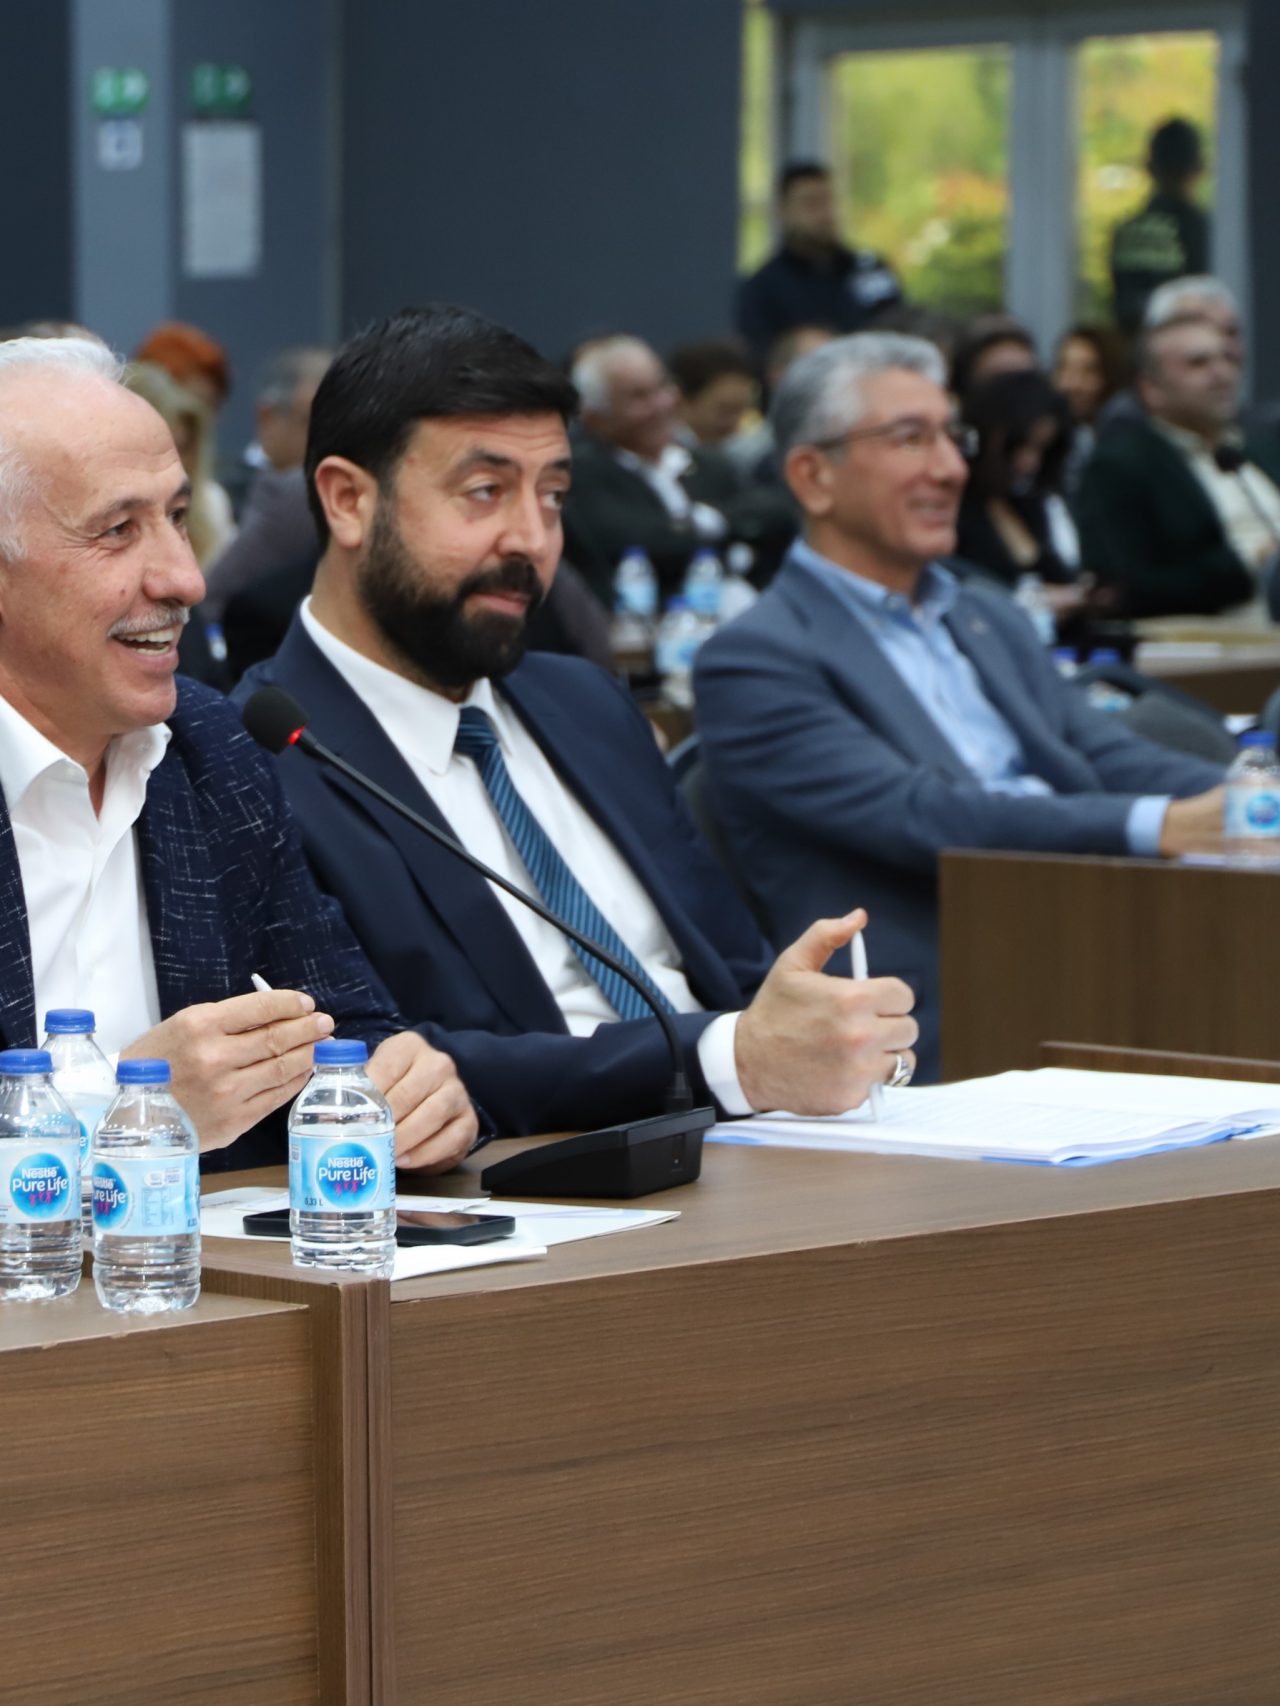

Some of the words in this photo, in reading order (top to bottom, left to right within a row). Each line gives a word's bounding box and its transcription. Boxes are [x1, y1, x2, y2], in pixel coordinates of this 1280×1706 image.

[12, 1178, 46, 1192] Pure
[47, 1176, 68, 1196] Life
[318, 1167, 351, 1181] Pure
[353, 1166, 376, 1186] Life
[106, 1189, 126, 1208] Life
